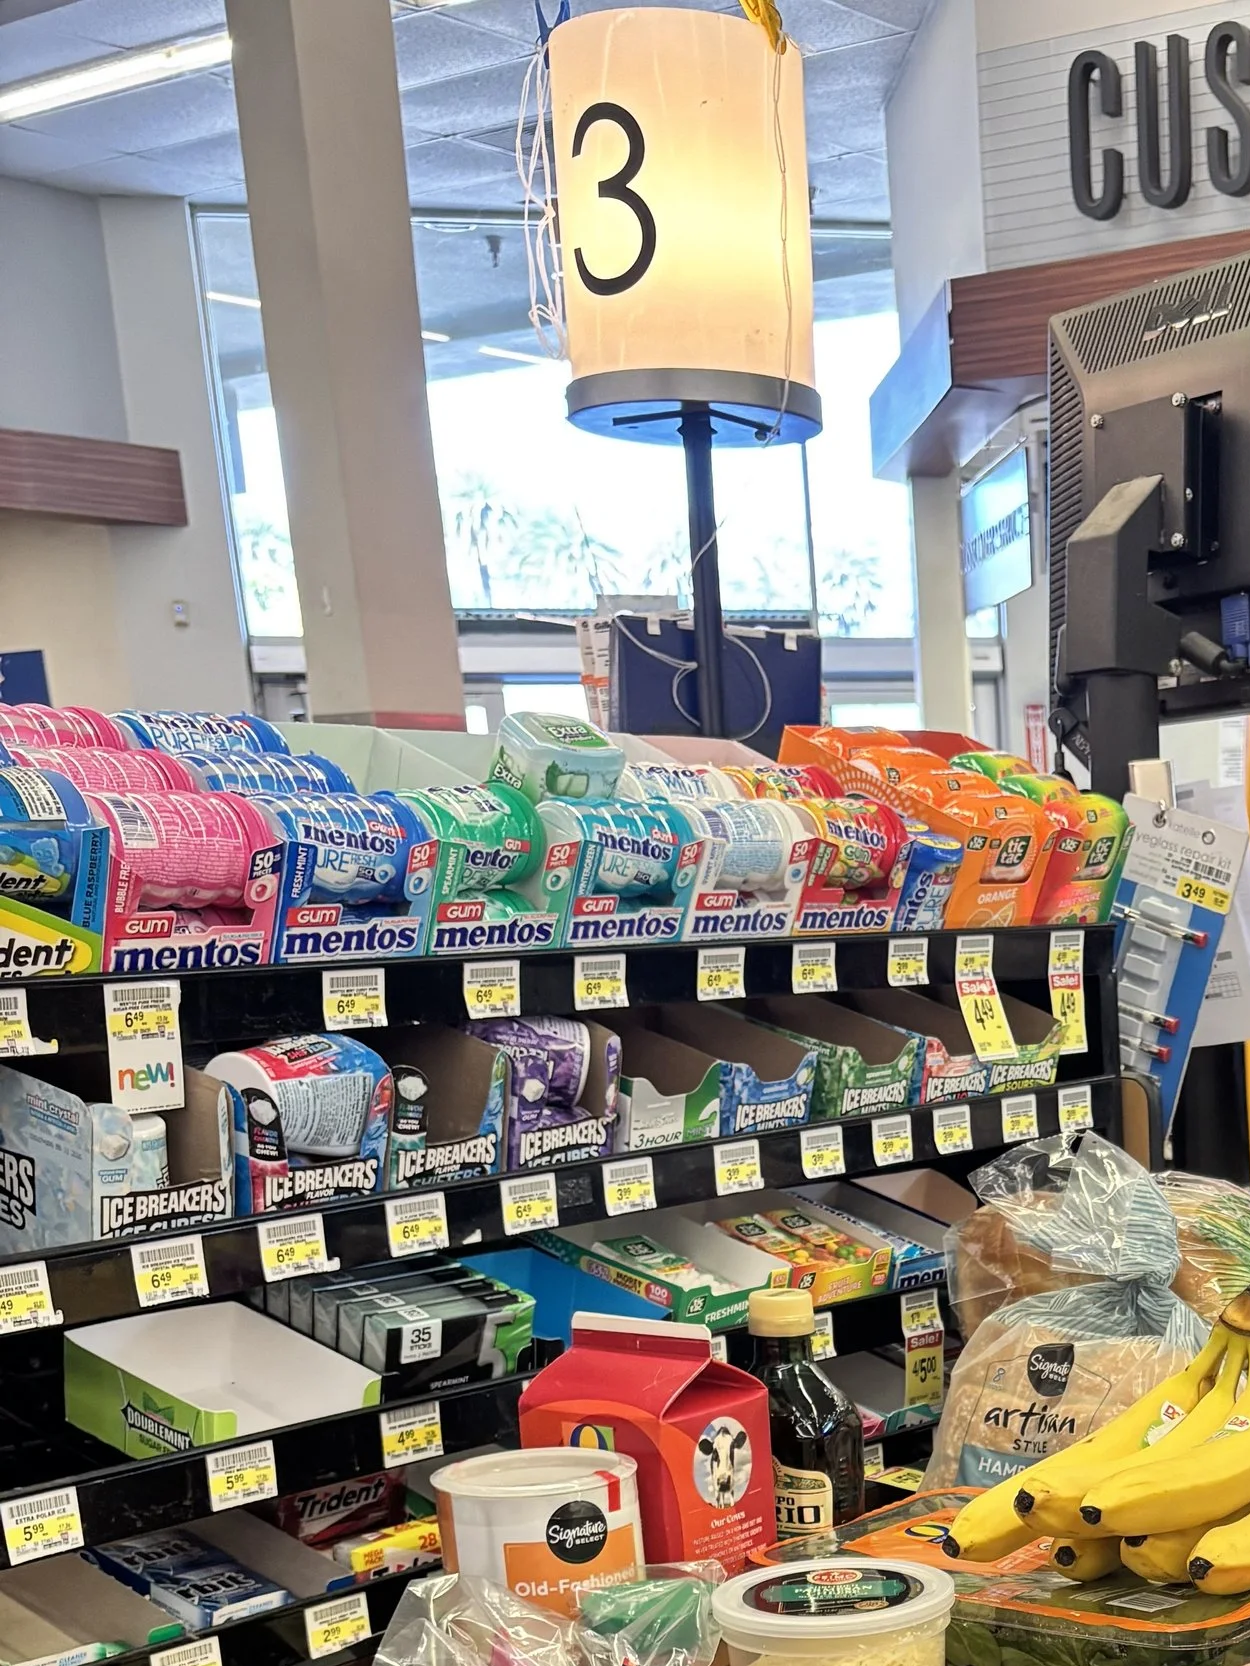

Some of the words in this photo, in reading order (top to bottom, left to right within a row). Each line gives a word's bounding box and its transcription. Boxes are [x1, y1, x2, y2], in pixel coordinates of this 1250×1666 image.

[571, 102, 657, 296] 3
[494, 766, 523, 791] Extra
[303, 822, 396, 855] mentos
[825, 818, 888, 850] mentos
[550, 845, 571, 862] 50
[597, 829, 672, 862] mentos
[1007, 838, 1024, 854] tic
[1096, 839, 1110, 854] tic
[85, 831, 102, 899] RASPBERRY
[253, 851, 274, 872] 50
[296, 846, 306, 869] MINT
[411, 848, 432, 866] 50
[1000, 851, 1023, 866] tac
[1088, 850, 1110, 865] tac
[1179, 844, 1215, 867] repair
[1218, 855, 1233, 871] kit
[441, 847, 459, 895] SPEARMINT
[577, 843, 598, 897] WINTERGREEN
[291, 869, 303, 898] FRESH
[1181, 882, 1206, 899] 349
[114, 881, 127, 914] BUBBLE
[582, 897, 615, 913] GUM
[703, 894, 734, 909] GUM
[976, 887, 1020, 906] ORANGE
[297, 910, 337, 925] GUM
[446, 904, 482, 920] GUM
[799, 907, 889, 930] mentos
[125, 917, 169, 934] GUM
[433, 917, 554, 952] mentos
[569, 914, 681, 943] mentos
[691, 911, 789, 937] mentos
[283, 922, 418, 956] mentos
[111, 938, 262, 973] mentos
[960, 980, 992, 995] Sale!
[1053, 974, 1079, 987] Sale!
[124, 1011, 145, 1028] 649
[974, 998, 995, 1031] 449
[989, 1065, 1007, 1088] ICE
[1006, 1058, 1053, 1081] BREAKERS
[926, 1078, 944, 1102] ICE
[943, 1068, 988, 1094] BREAKERS
[1004, 1078, 1035, 1092] SOURS
[842, 1087, 860, 1114] ICE
[858, 1079, 907, 1108] BREAKERS
[26, 1092, 48, 1112] mint
[49, 1104, 80, 1125] crystal
[735, 1103, 756, 1132] ICE
[755, 1094, 806, 1121] BREAKERS
[519, 1131, 544, 1164] ICE
[543, 1117, 609, 1154] BREAKERS
[634, 1134, 646, 1148] 3
[646, 1131, 682, 1144] HOUR
[399, 1149, 426, 1181] ICE
[426, 1133, 497, 1170] BREAKERS
[100, 1173, 124, 1184] GUM
[265, 1173, 294, 1206] ICE
[294, 1158, 378, 1196] BREAKERS
[102, 1195, 135, 1233] ICE
[135, 1179, 228, 1221] BREAKERS
[402, 1222, 420, 1240] 649
[276, 1248, 296, 1264] 649
[150, 1272, 172, 1289] 649
[817, 1282, 863, 1305] ADVENTURE
[410, 1326, 432, 1344] 35
[910, 1332, 940, 1349] Sale!
[430, 1375, 470, 1390] SPEARMINT
[127, 1407, 191, 1451] DOUBLEMINT
[984, 1401, 1077, 1437] artisan
[397, 1429, 416, 1445] 499
[1012, 1438, 1049, 1455] STYLE
[226, 1473, 245, 1490] 599
[299, 1478, 386, 1520] Trident
[711, 1517, 725, 1529] Our
[724, 1511, 746, 1523] Cows
[23, 1523, 45, 1542] 599
[418, 1532, 438, 1551] 28
[548, 1519, 606, 1549] Signature
[575, 1534, 605, 1545] SELECT
[323, 1626, 342, 1643] 299
